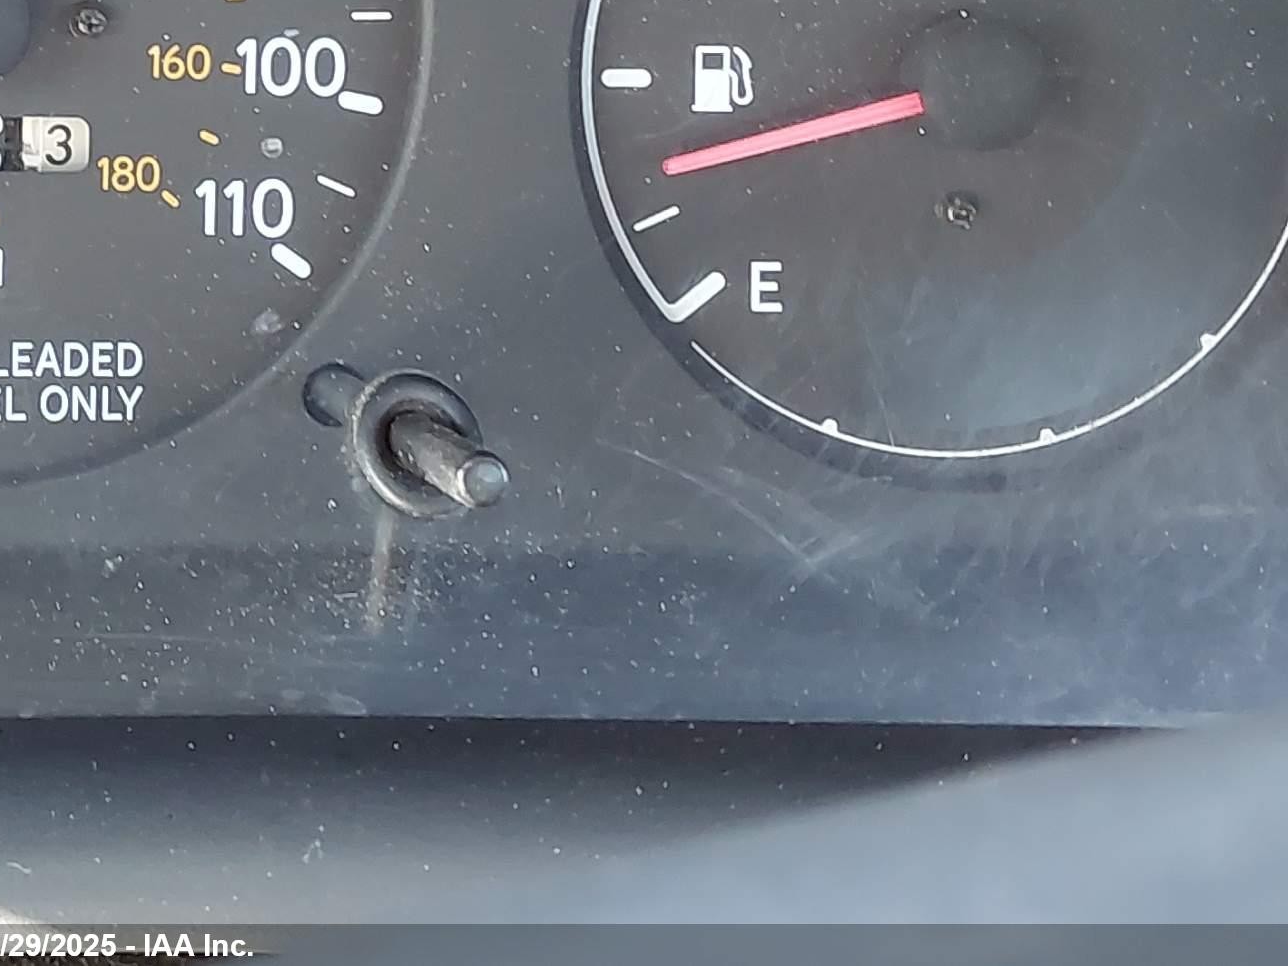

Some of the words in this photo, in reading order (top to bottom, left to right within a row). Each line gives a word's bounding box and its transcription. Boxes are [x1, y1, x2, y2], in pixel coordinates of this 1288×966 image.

[150, 43, 213, 80] 160
[236, 36, 349, 99] 100
[97, 154, 162, 193] 180
[195, 178, 294, 239] 110
[750, 261, 783, 313] E
[40, 384, 144, 422] ONLY
